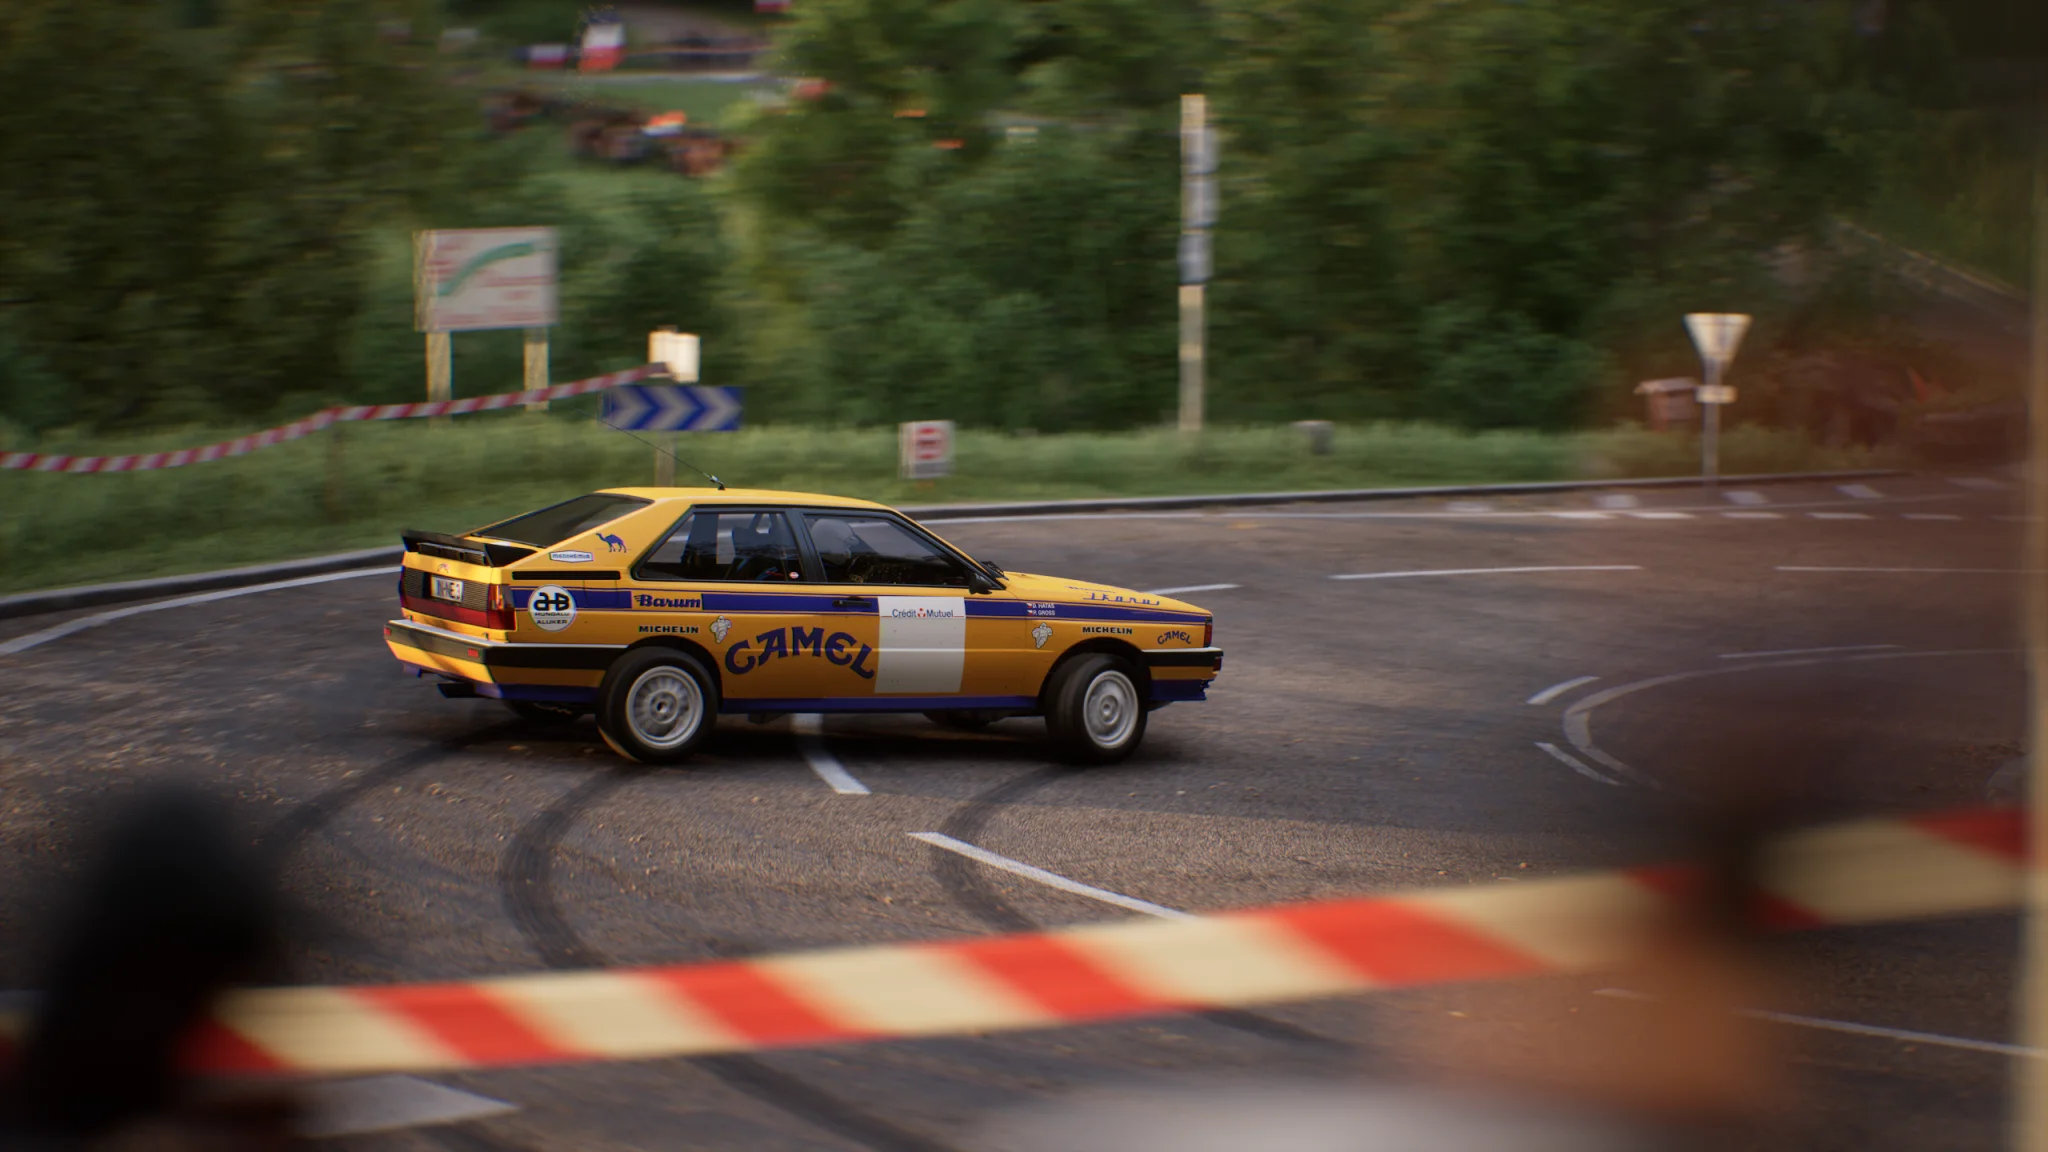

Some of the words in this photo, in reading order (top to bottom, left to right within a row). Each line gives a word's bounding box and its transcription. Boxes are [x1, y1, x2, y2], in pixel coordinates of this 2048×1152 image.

[634, 594, 701, 608] Barum
[892, 608, 917, 618] Crédit
[926, 609, 954, 618] Mutuel
[638, 625, 700, 633] MICHELIN
[1082, 626, 1133, 635] MICHELIN
[1157, 630, 1192, 645] CAMEL
[725, 626, 875, 680] CAMEL
